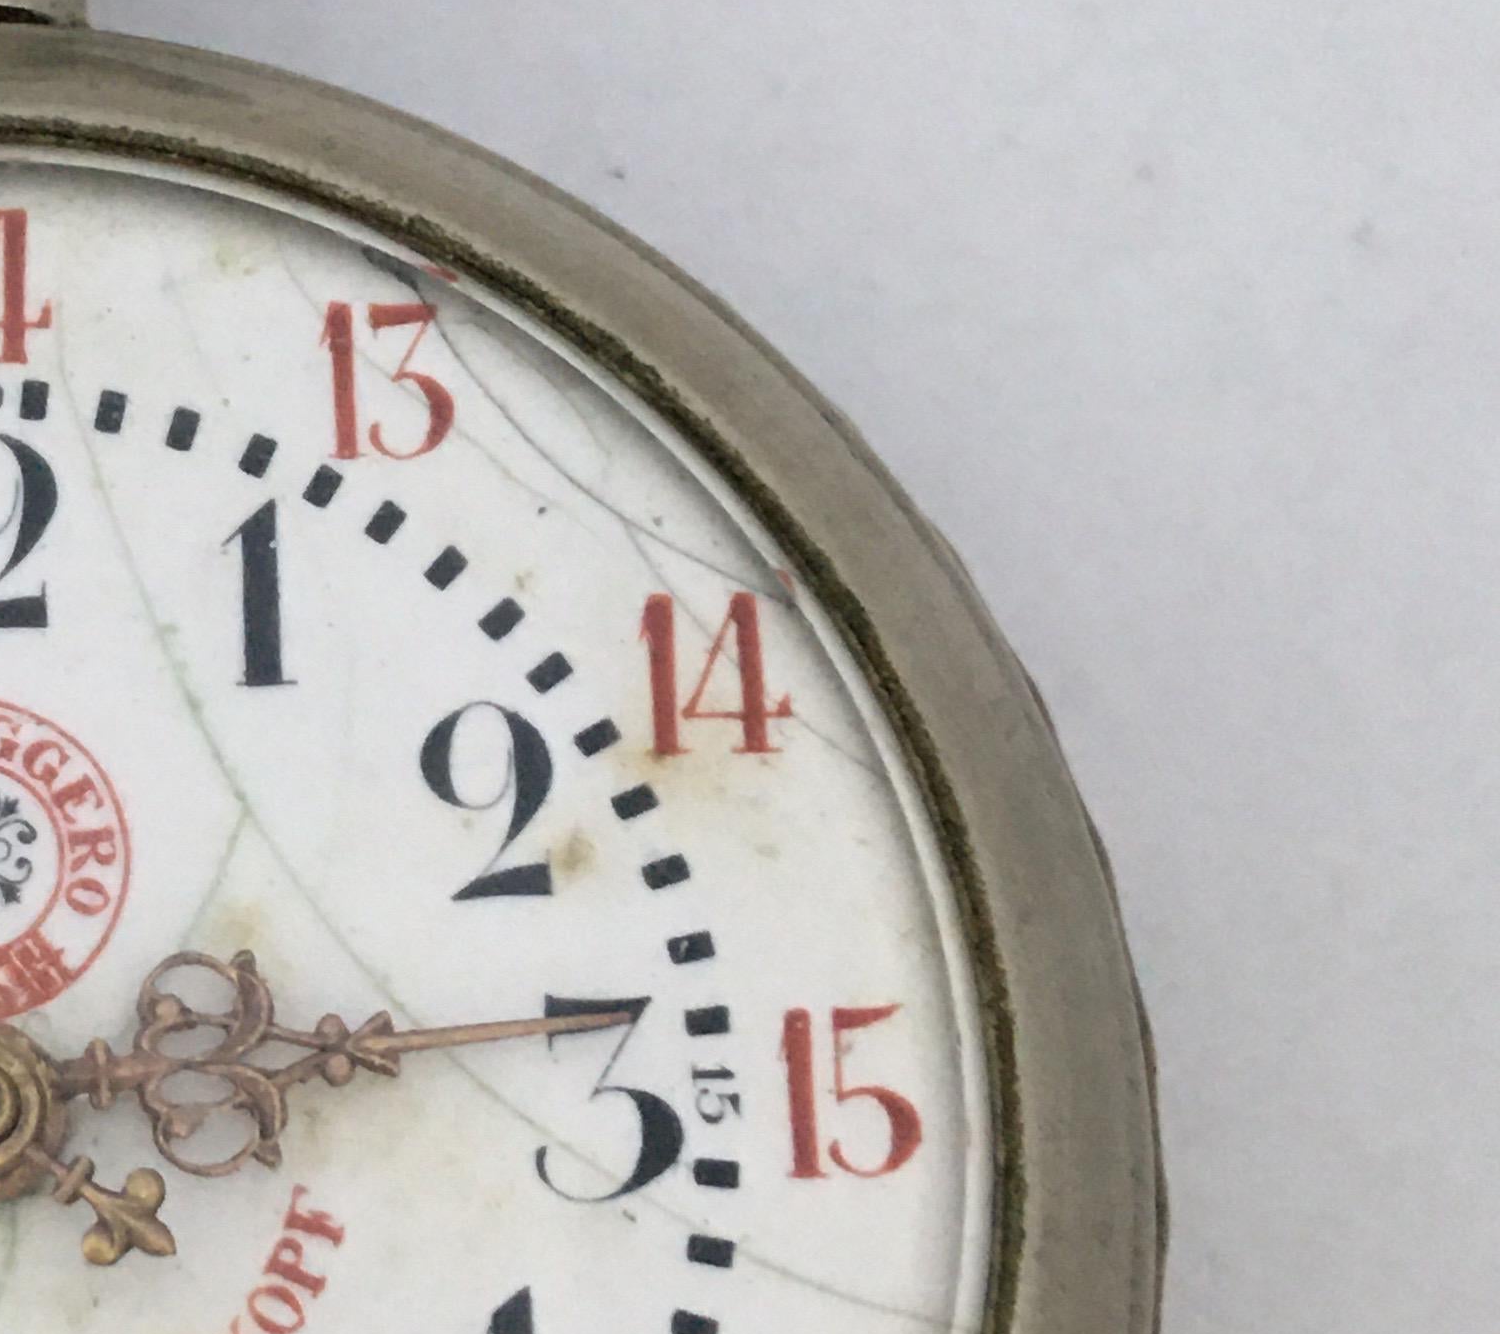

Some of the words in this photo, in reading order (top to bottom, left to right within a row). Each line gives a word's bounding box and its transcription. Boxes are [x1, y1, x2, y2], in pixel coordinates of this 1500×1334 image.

[319, 300, 456, 460] 13
[220, 498, 299, 687] 1
[638, 591, 794, 757] 14
[418, 699, 554, 904] 2
[534, 994, 678, 1204] 3
[690, 1063, 742, 1126] 15
[778, 1003, 925, 1181] 15
